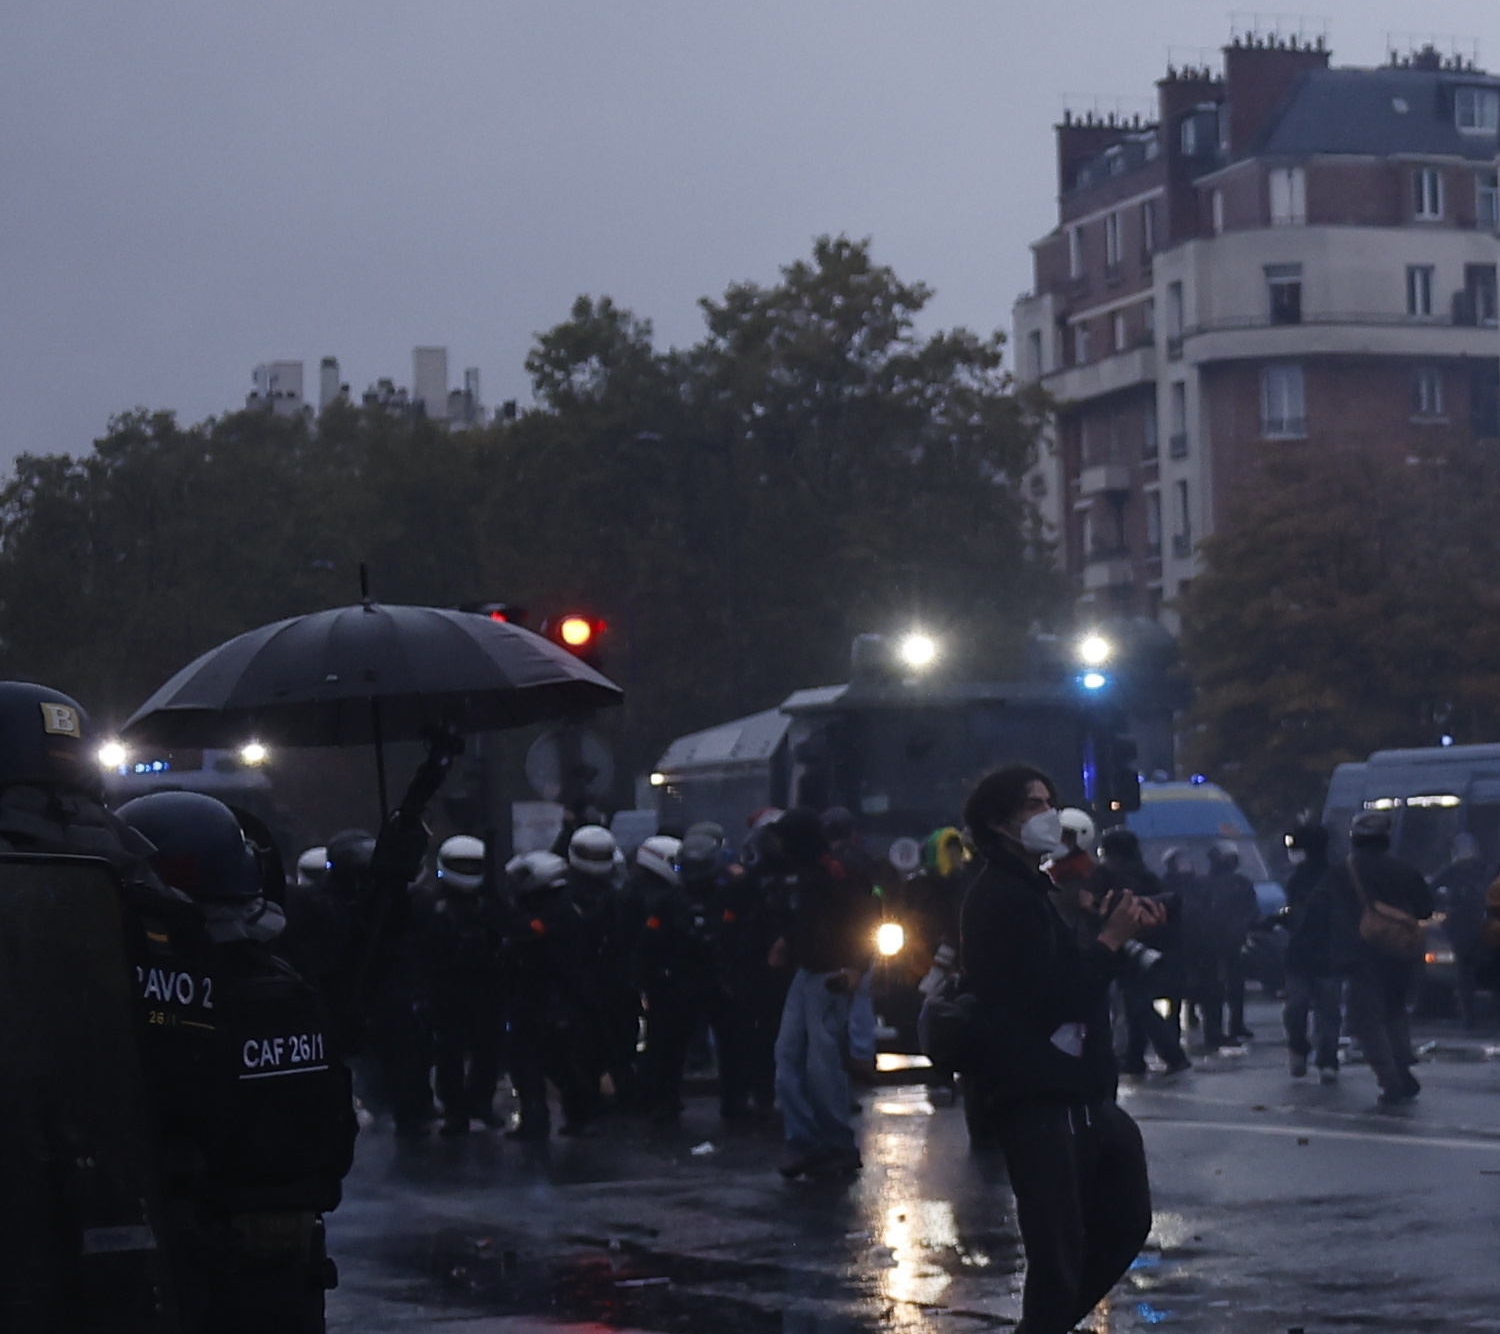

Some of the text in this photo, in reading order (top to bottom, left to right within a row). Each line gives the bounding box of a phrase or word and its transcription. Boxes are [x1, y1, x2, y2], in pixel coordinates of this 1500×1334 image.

[51, 705, 75, 732] B
[201, 978, 214, 1010] 2
[242, 1032, 325, 1069] CAF 26/1
